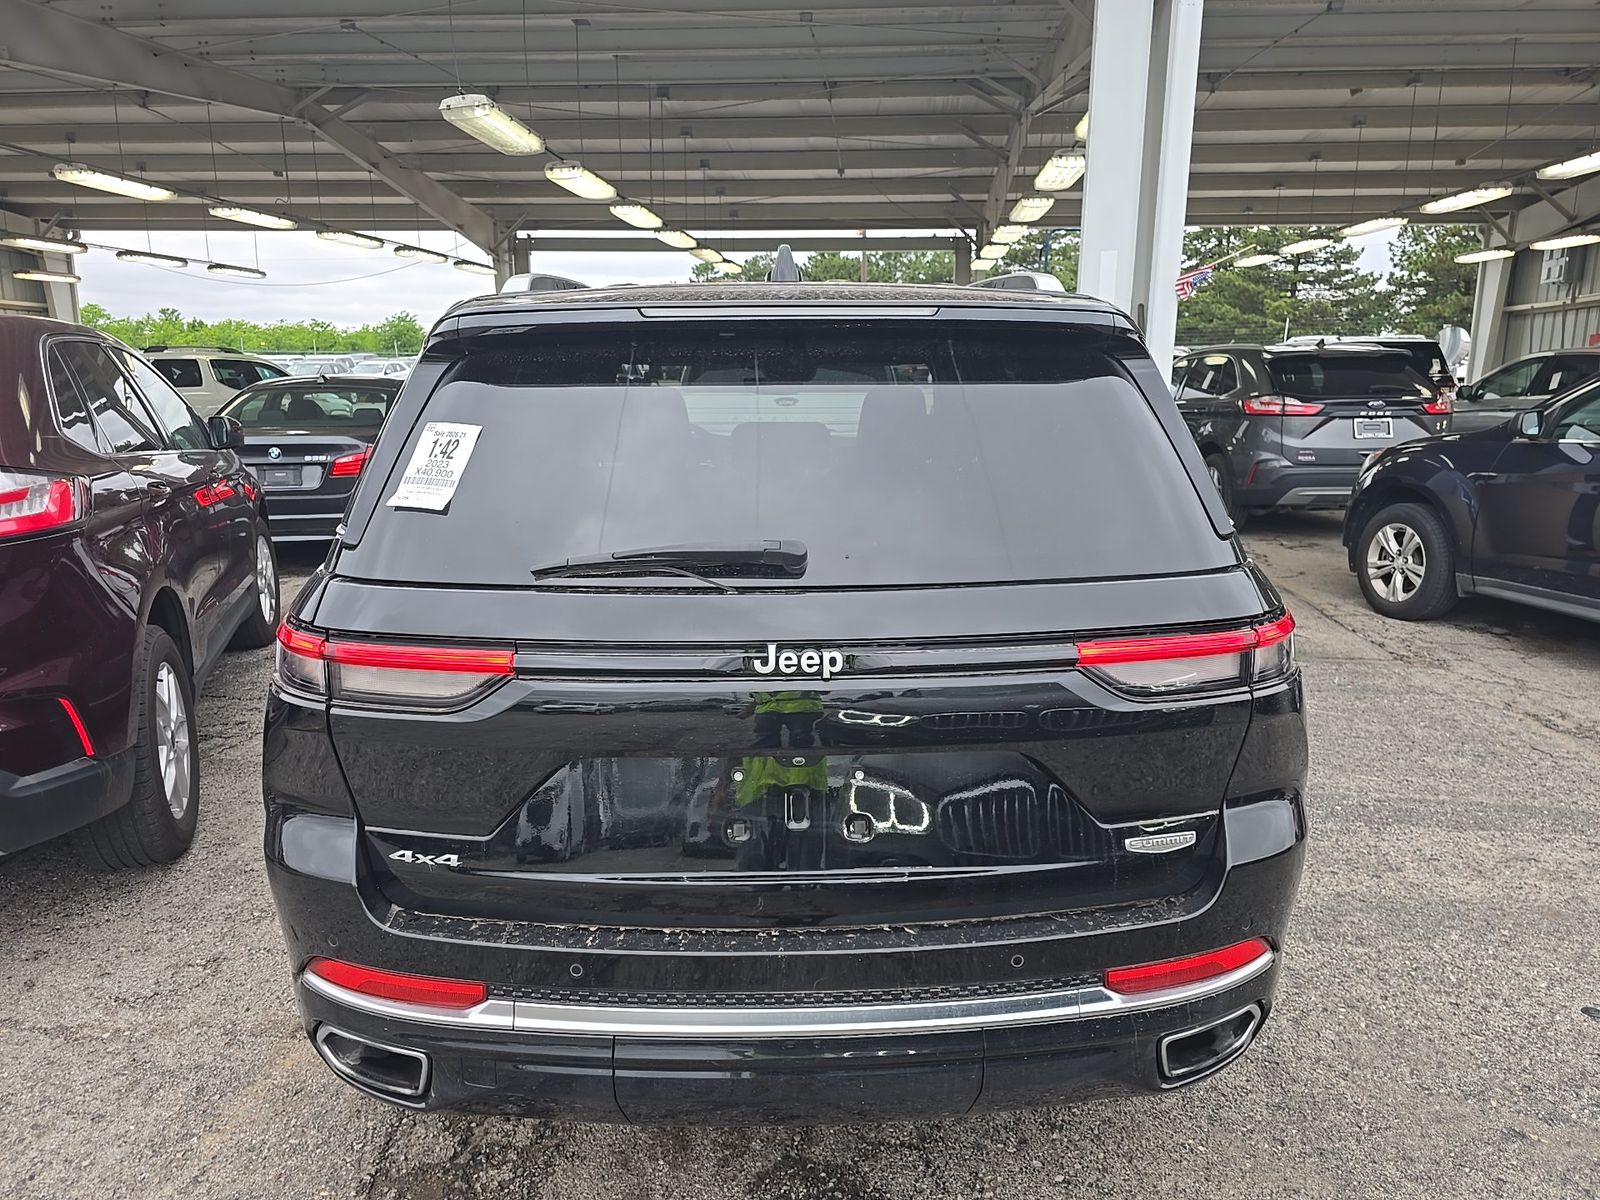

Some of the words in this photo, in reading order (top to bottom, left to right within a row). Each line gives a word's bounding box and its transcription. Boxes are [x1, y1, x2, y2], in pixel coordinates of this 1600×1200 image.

[428, 438, 460, 460] 1:42
[425, 459, 450, 469] 2023
[753, 643, 844, 680] Jeep
[1130, 835, 1193, 848] SUMMIT
[388, 849, 463, 867] 4x4
